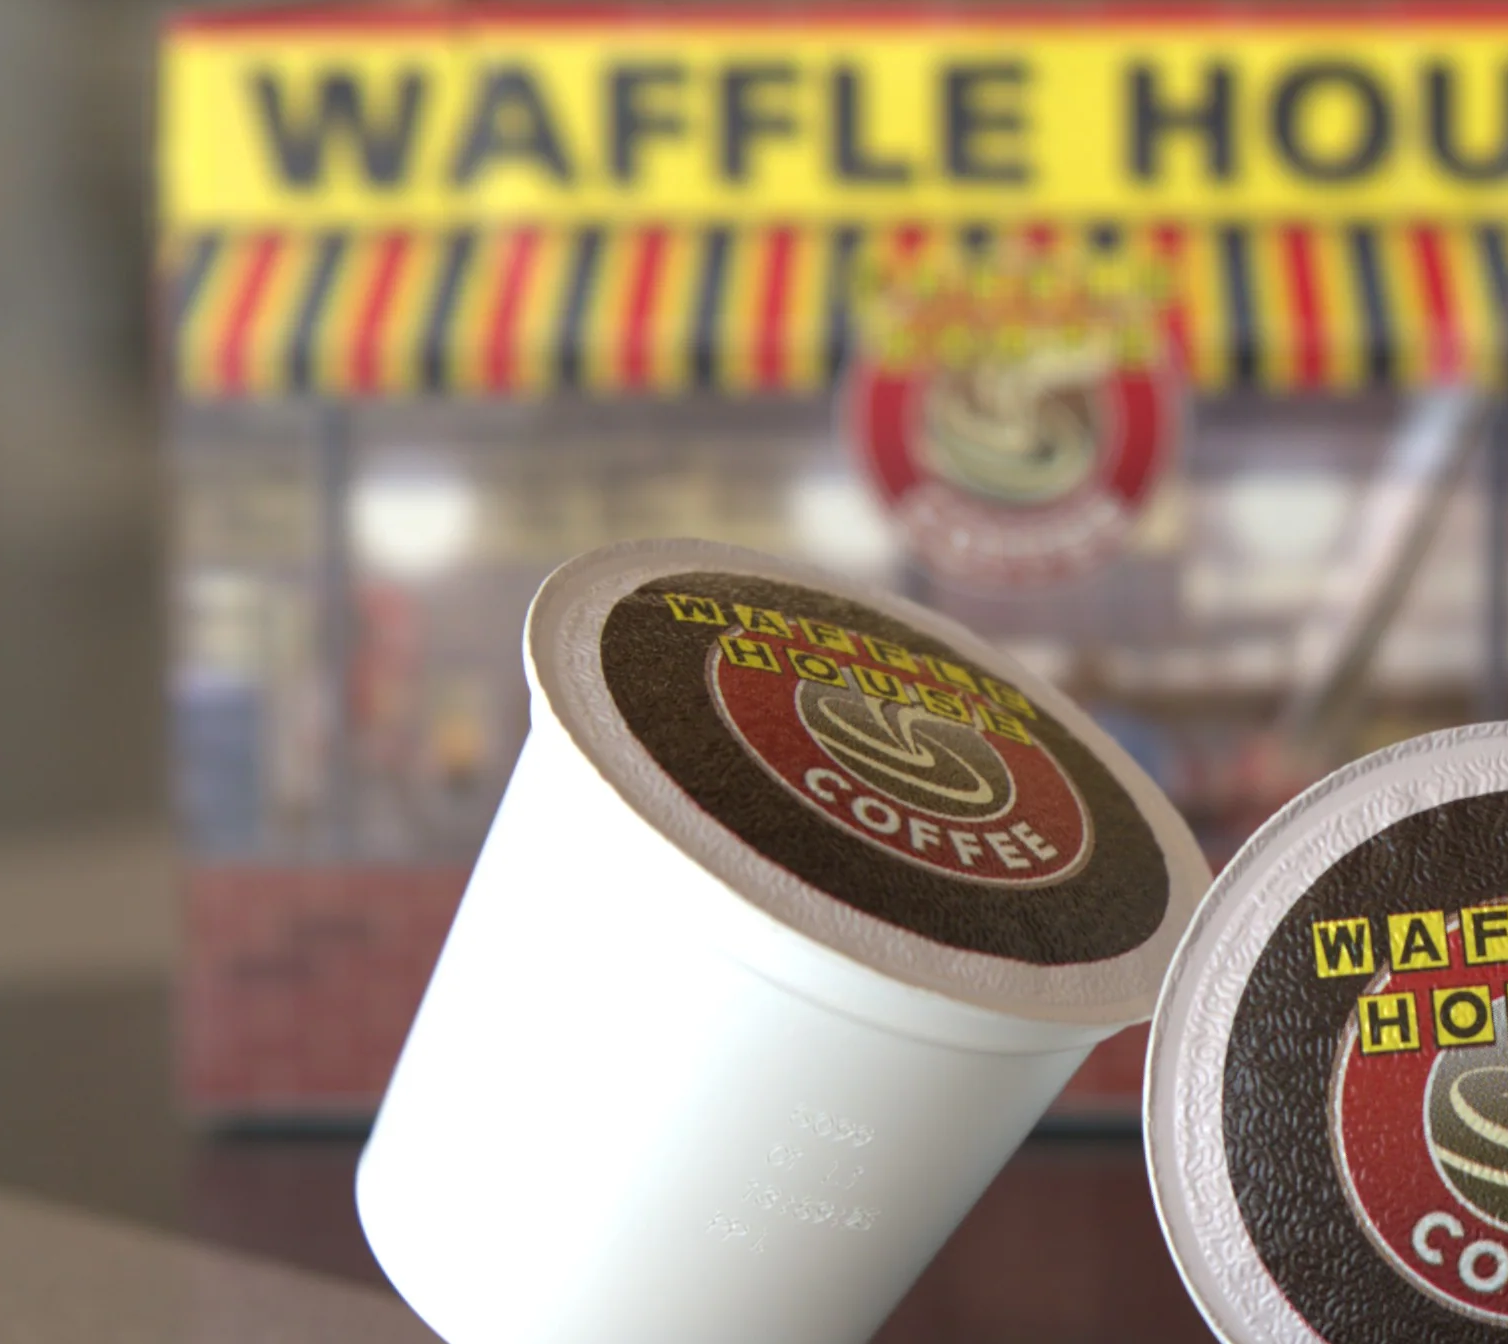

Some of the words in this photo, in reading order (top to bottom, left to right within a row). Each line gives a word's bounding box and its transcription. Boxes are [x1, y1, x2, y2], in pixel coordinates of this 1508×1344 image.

[247, 56, 1033, 190] WAFFLE
[670, 596, 1035, 717] WAFFLE
[722, 638, 1031, 743] HOUSE
[803, 767, 1059, 870] COFFEE
